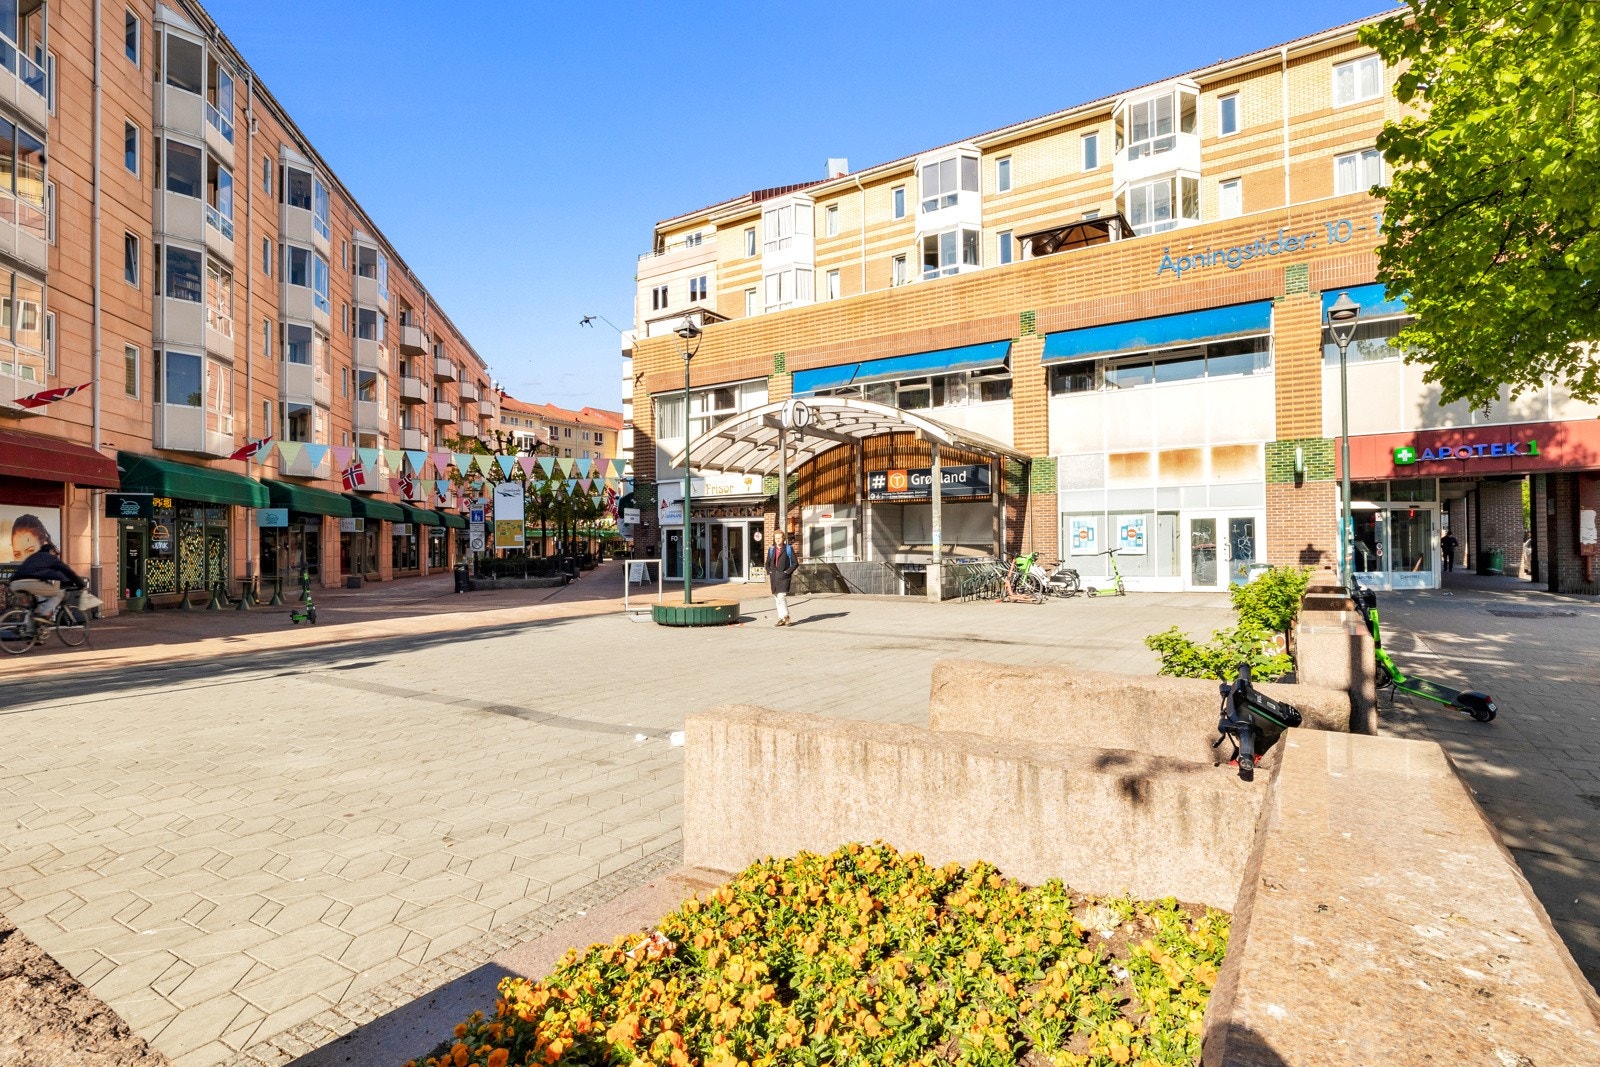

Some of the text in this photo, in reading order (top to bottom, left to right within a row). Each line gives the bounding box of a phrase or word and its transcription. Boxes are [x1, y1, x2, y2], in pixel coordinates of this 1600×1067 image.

[1157, 228, 1317, 278] Åpningstider:
[1325, 219, 1353, 244] 10
[1420, 440, 1540, 460] APOTEK 1
[911, 470, 967, 485] Grøland
